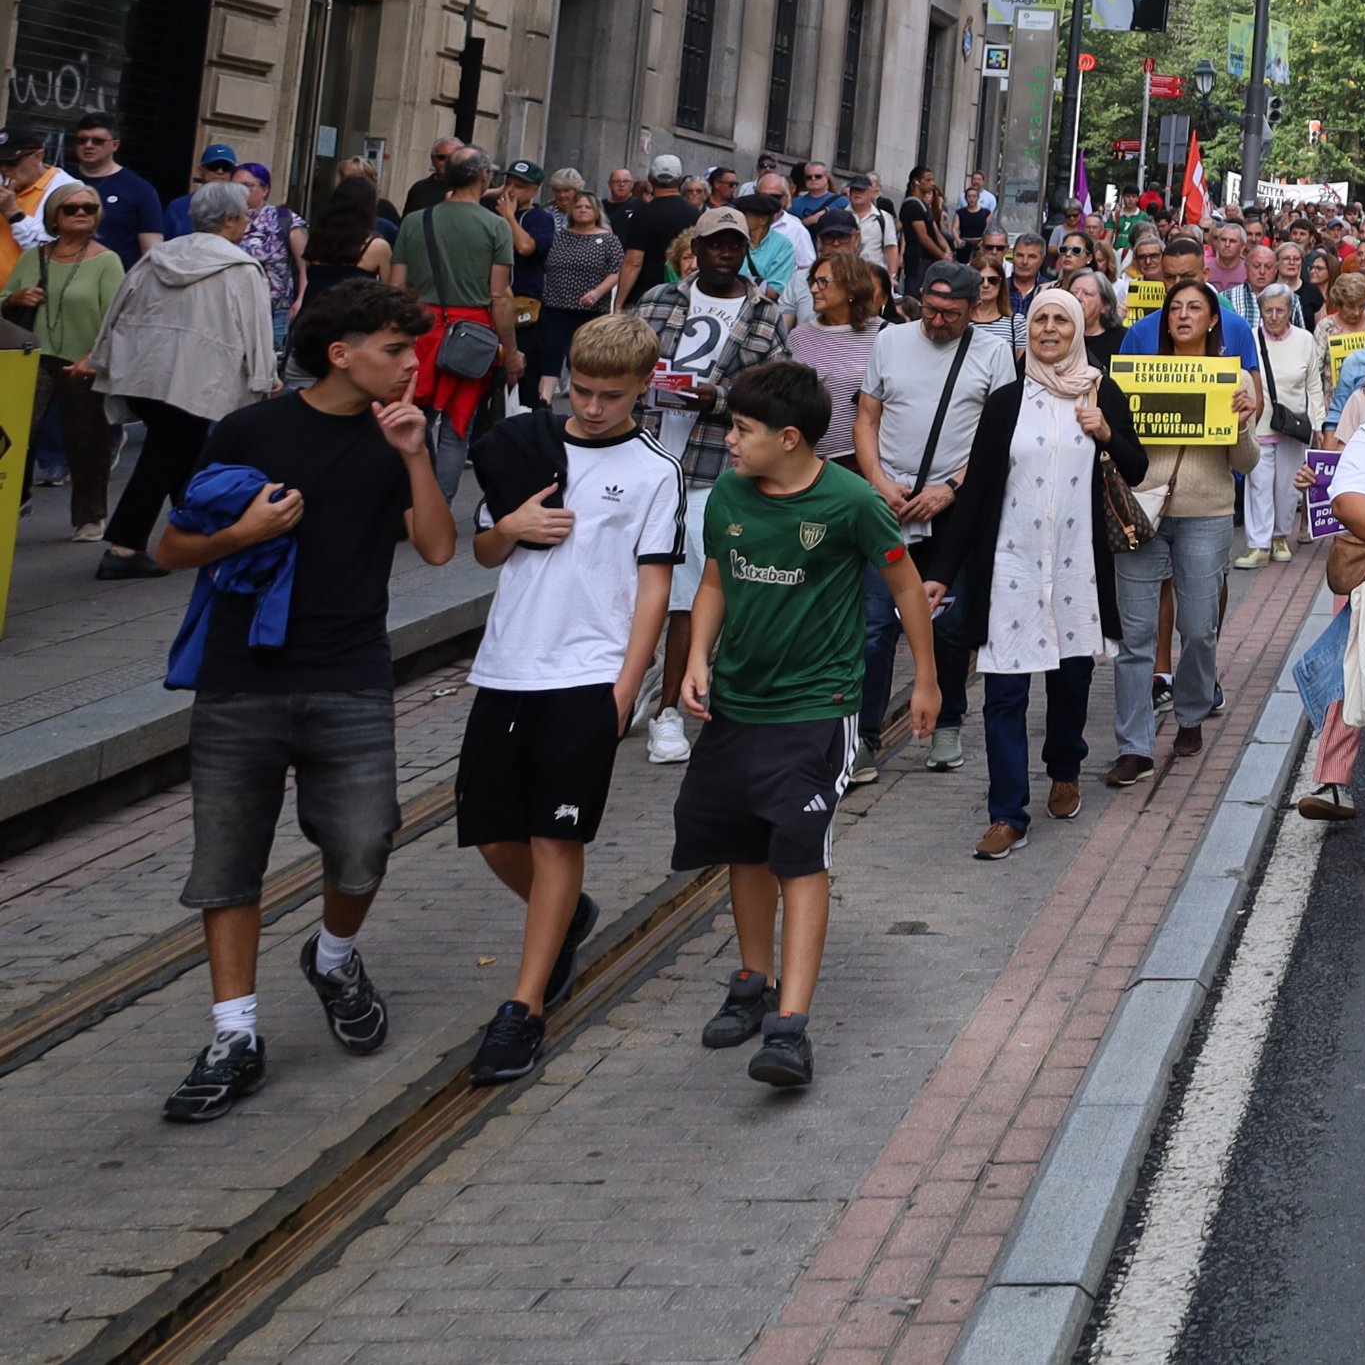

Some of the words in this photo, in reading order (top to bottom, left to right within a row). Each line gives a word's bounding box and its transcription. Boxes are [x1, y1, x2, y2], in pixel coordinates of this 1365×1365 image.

[672, 316, 722, 378] 2
[1135, 362, 1203, 372] ETXEBIZITZA
[1135, 373, 1196, 383] ESKUBIDEA
[1202, 374, 1216, 383] DA
[1129, 394, 1141, 412] O
[1133, 412, 1182, 423] NEGOCIO
[1151, 423, 1204, 435] VIVIENDA
[1208, 426, 1232, 435] LAB
